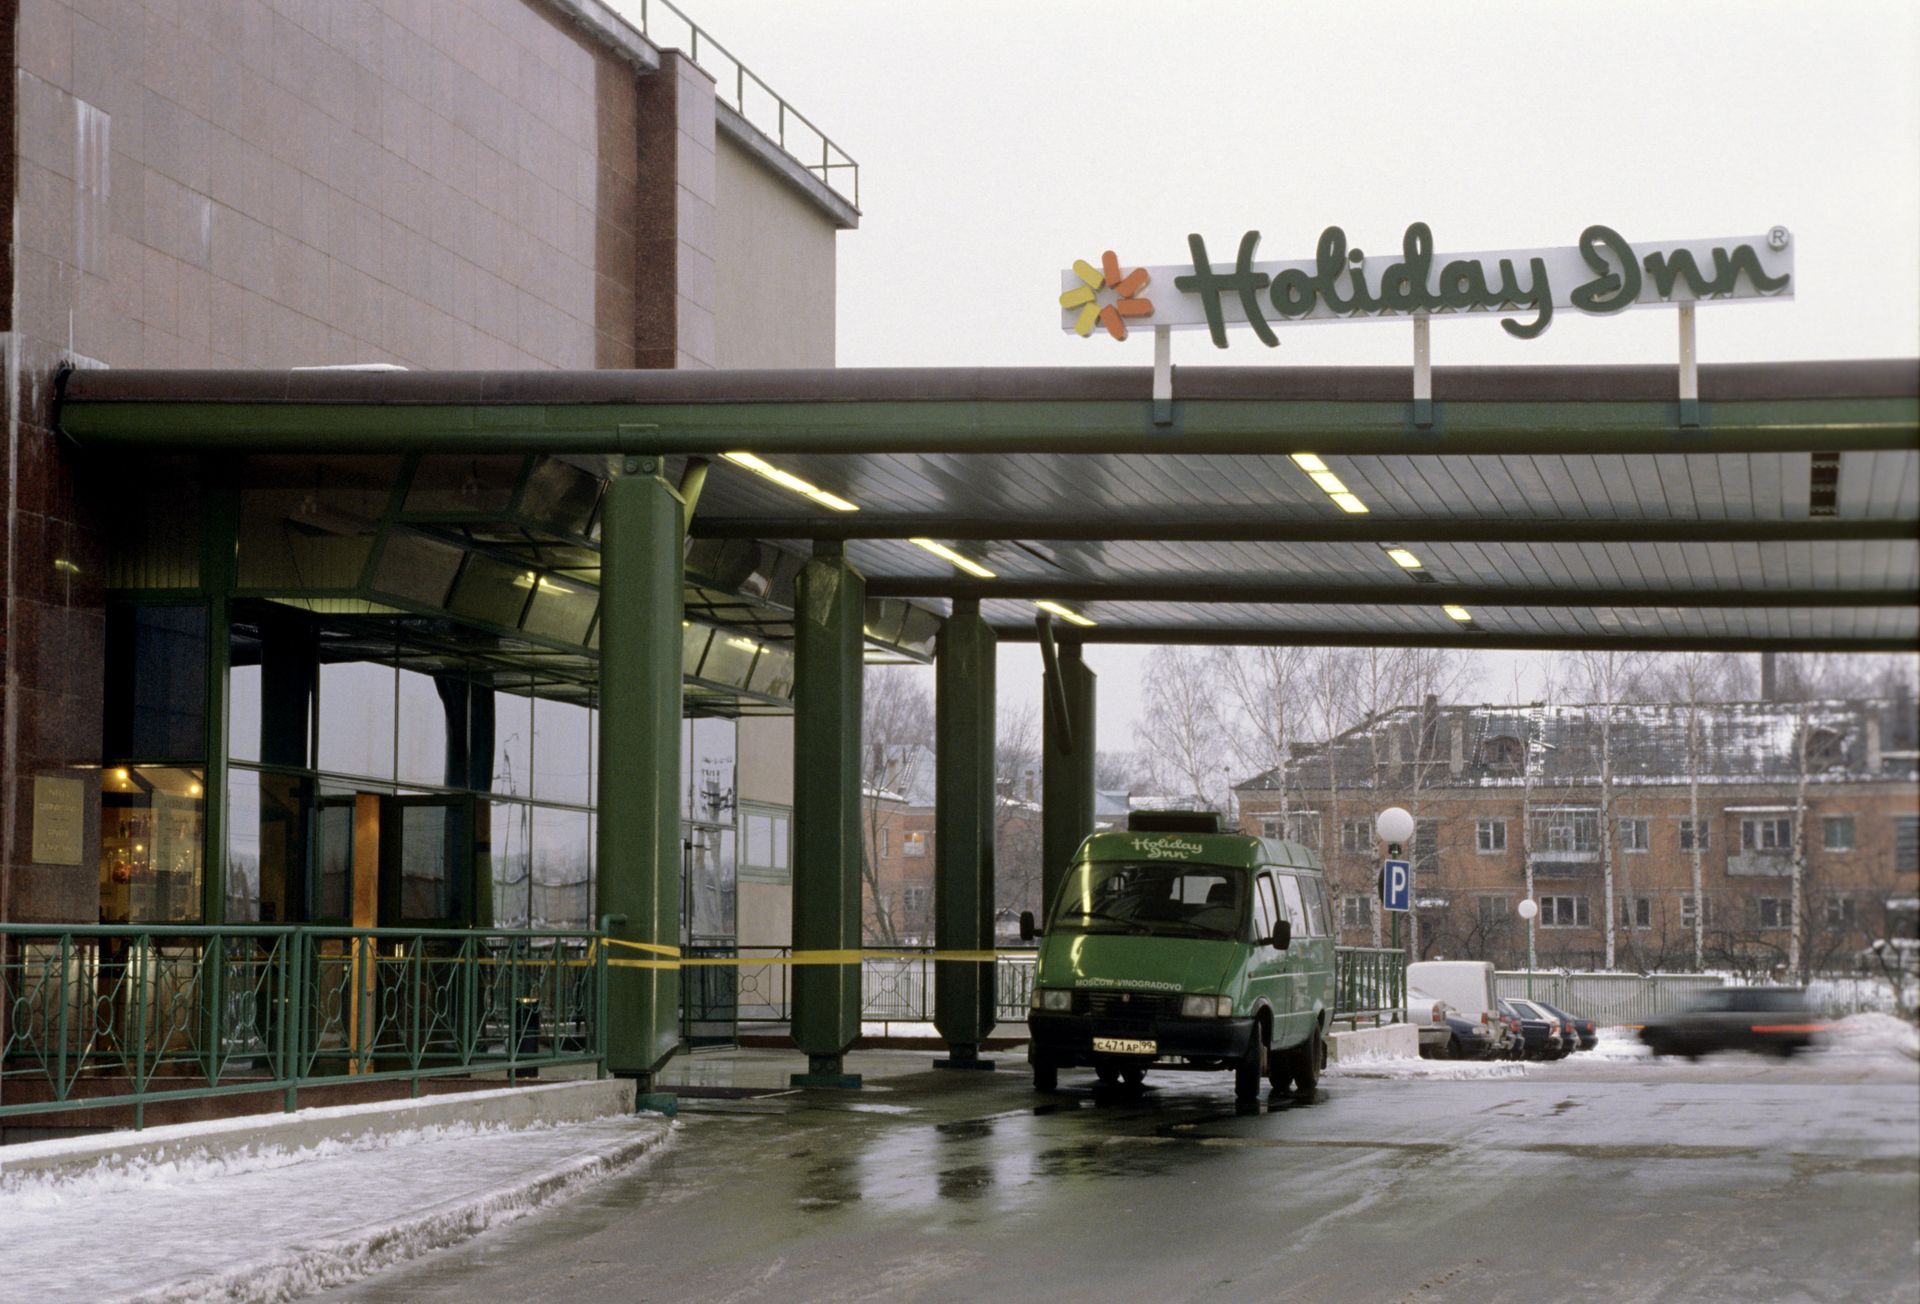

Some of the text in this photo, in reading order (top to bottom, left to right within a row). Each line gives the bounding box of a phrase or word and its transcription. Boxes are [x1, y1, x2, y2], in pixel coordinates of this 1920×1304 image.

[1174, 221, 1554, 349] Holiday
[1569, 224, 1791, 315] Inn
[1131, 838, 1202, 854] Holiday
[1147, 847, 1188, 859] Inn
[1391, 866, 1406, 905] P
